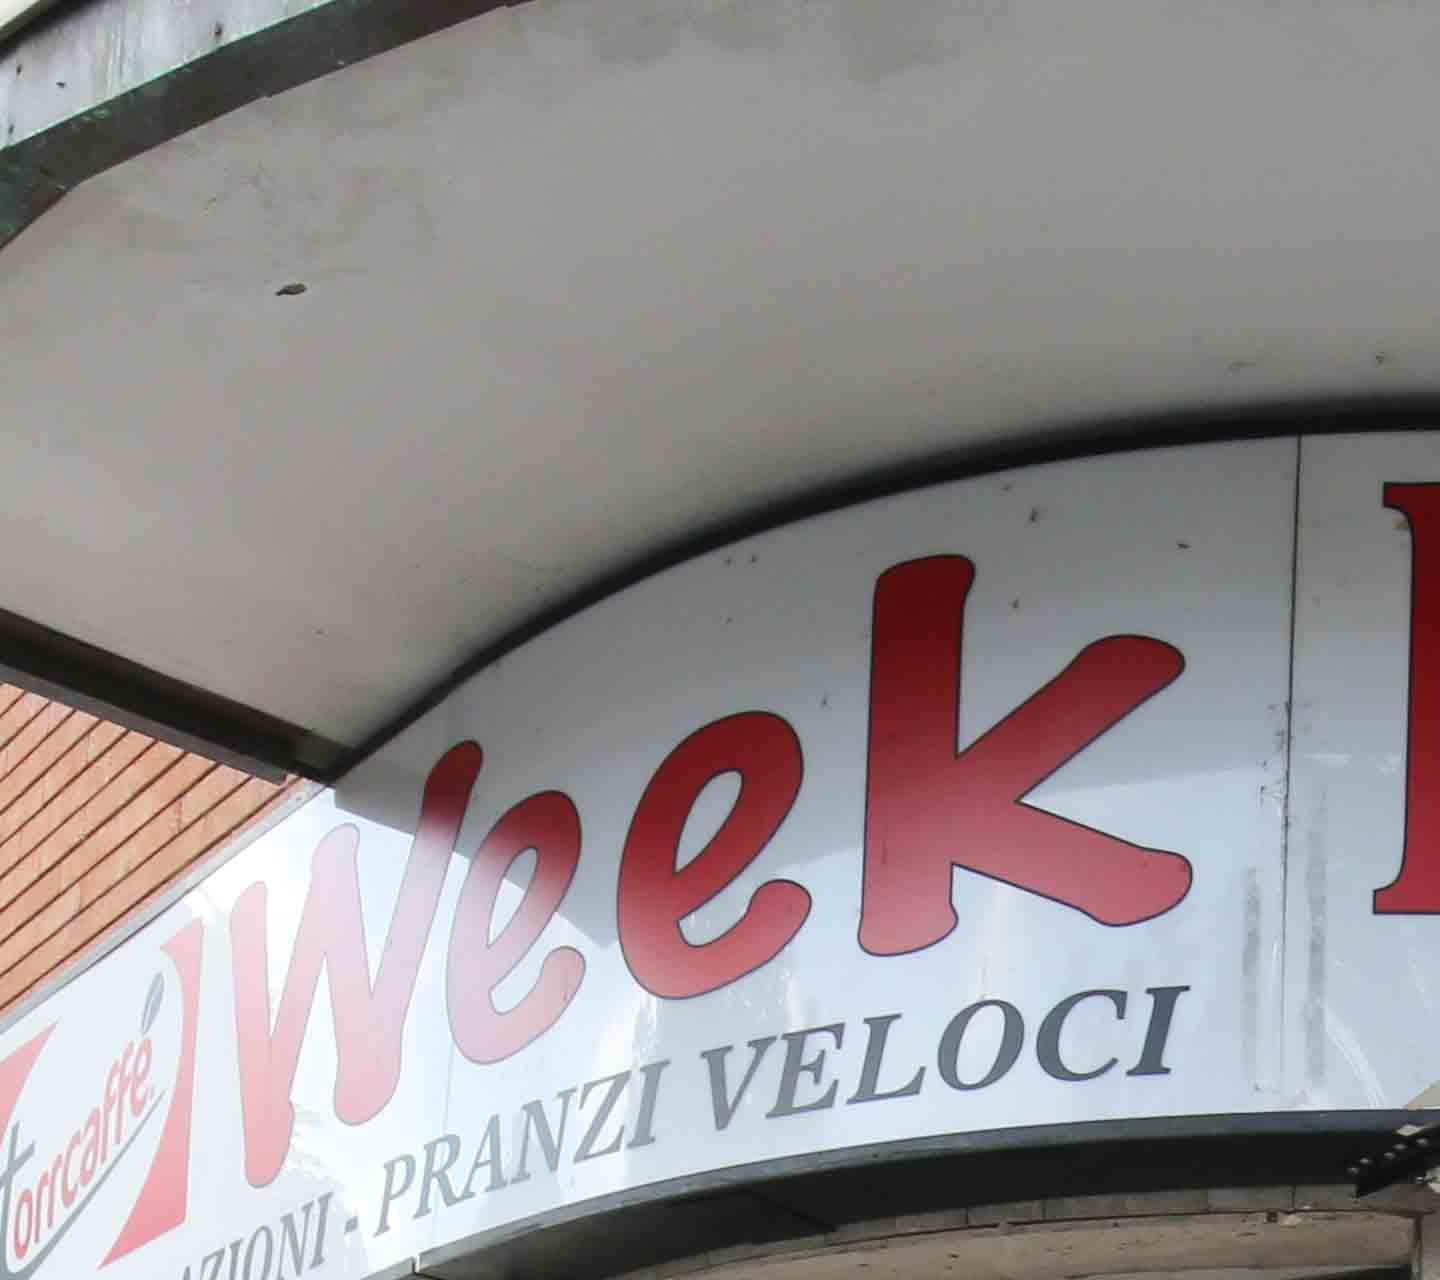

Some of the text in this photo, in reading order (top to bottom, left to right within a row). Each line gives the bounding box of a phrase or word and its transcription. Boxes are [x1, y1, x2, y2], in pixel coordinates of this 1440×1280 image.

[228, 553, 1194, 1190] Week
[373, 1060, 671, 1238] PRANZI
[699, 984, 1192, 1133] VELOCI
